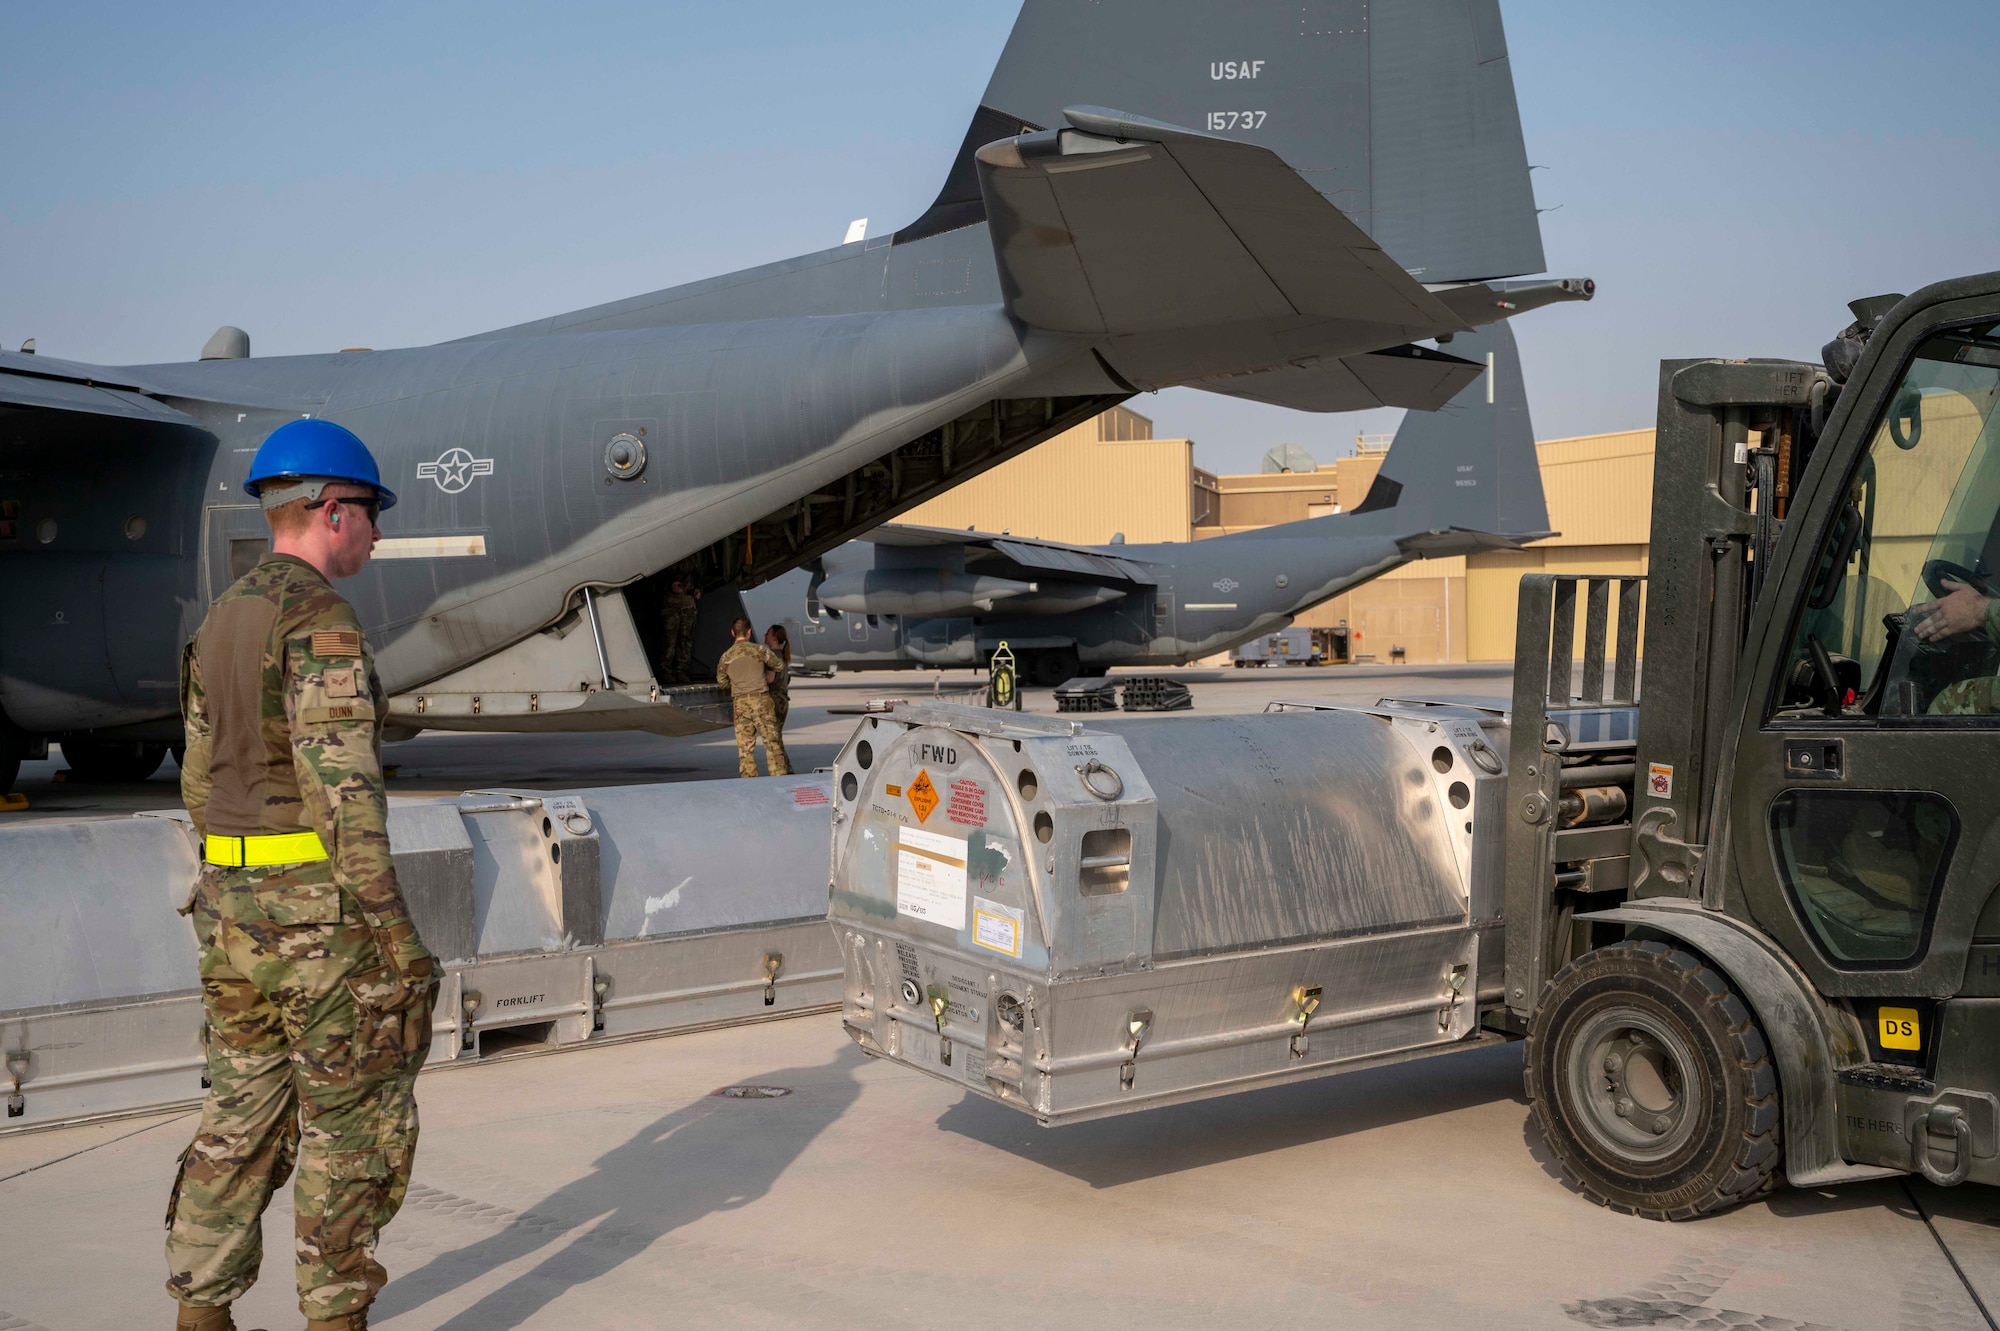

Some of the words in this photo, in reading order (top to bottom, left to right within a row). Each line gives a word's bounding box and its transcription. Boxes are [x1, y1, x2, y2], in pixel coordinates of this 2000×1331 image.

[1210, 60, 1265, 80] USAF
[1207, 110, 1267, 131] 15737
[1776, 371, 1805, 383] LIFT
[1775, 384, 1804, 397] HER
[329, 706, 353, 718] DUNN
[922, 744, 956, 764] FWD
[955, 791, 974, 799] PROXIMITY
[951, 796, 972, 806] CONTAINER
[950, 816, 971, 824] INSTALLING
[958, 812, 978, 820] REMOVING
[896, 942, 915, 953] CAUTION
[898, 949, 918, 960] RELEASE
[898, 956, 918, 967] PRESSURE
[902, 963, 918, 972] BEFORE
[902, 969, 920, 979] OPENING
[948, 982, 969, 993] DOCUMENT
[496, 994, 546, 1008] FORKLIFT
[1886, 1020, 1912, 1036] DS
[1846, 1115, 1864, 1129] TIE
[1868, 1120, 1904, 1134] HERE
